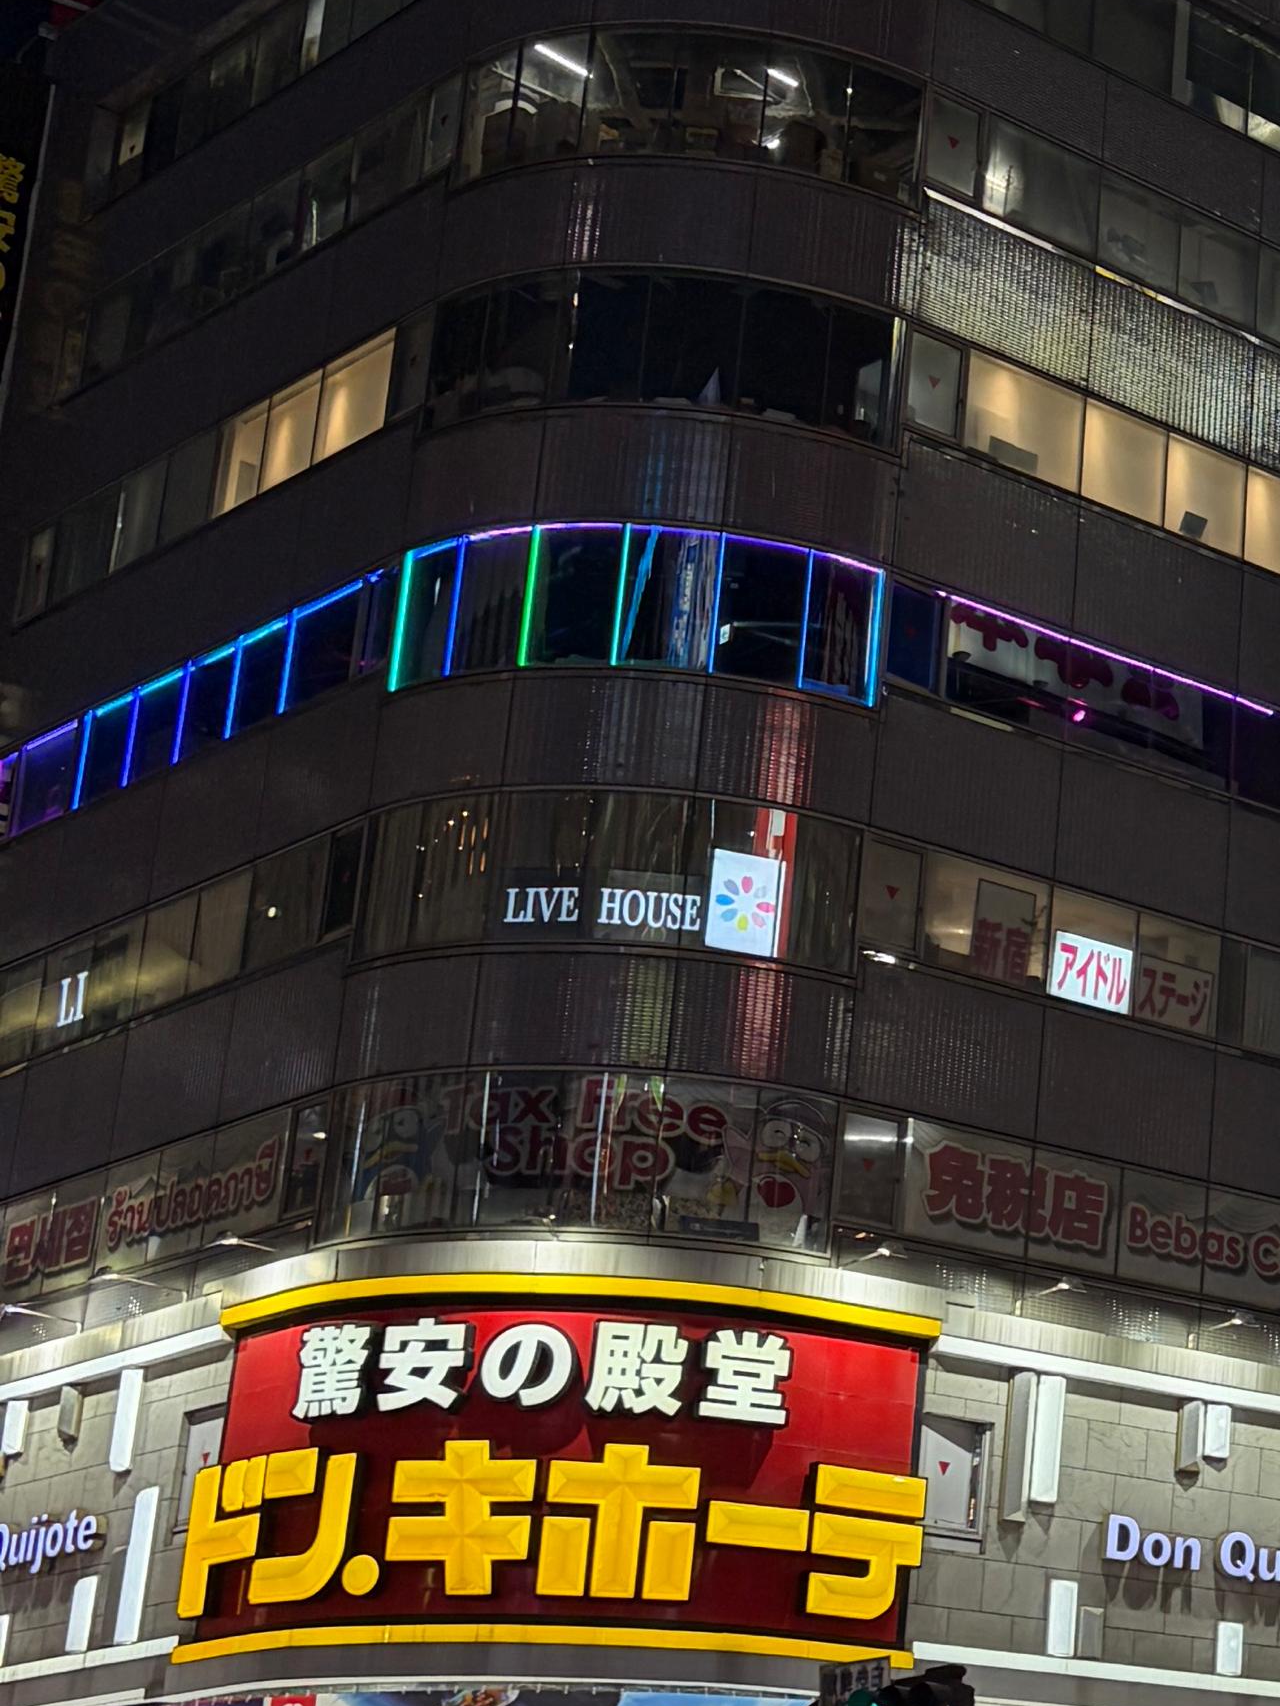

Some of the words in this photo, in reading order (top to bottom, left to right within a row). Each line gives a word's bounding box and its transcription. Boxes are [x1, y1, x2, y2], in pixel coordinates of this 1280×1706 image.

[504, 887, 579, 925] LIVE
[598, 887, 701, 932] HOUSE
[1055, 943, 1129, 1013] アイドル
[445, 1081, 550, 1139] Tax
[578, 1077, 728, 1142] Free
[486, 1122, 674, 1192] Shop
[925, 1139, 1108, 1250] 免税店
[1126, 1200, 1244, 1270] Bebas
[290, 1318, 792, 1426] 驚安の殿堂
[1105, 1513, 1202, 1572] Don
